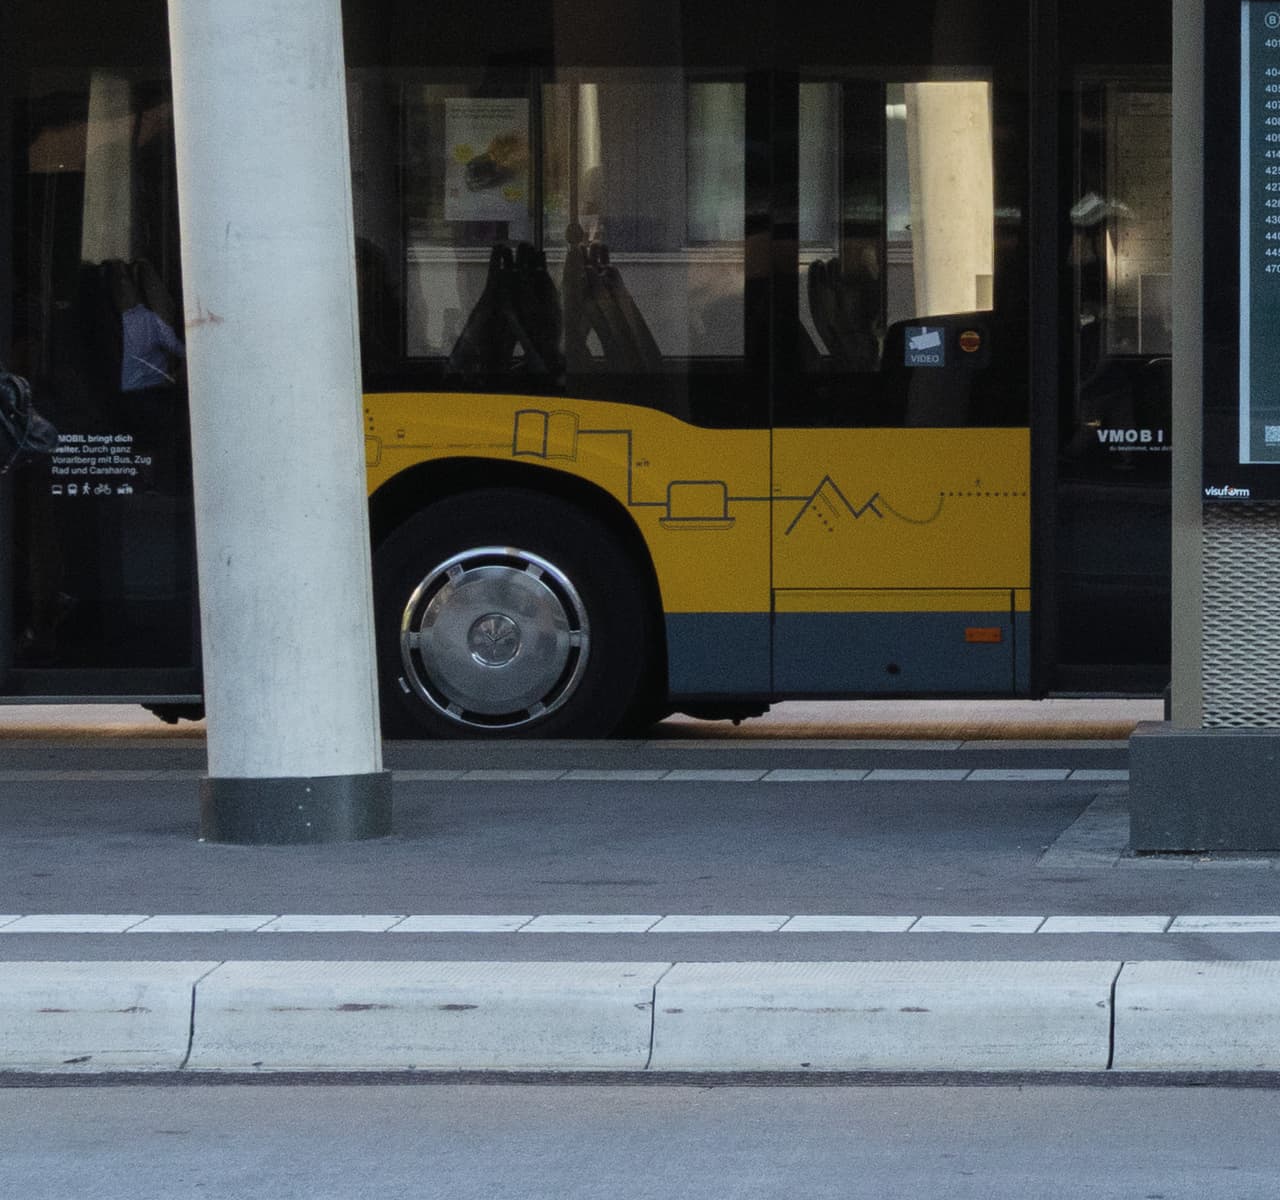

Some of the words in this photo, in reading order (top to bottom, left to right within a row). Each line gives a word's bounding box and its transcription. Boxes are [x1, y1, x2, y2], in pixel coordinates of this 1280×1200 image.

[1265, 39, 1280, 48] 401
[1266, 150, 1280, 159] 414
[911, 355, 939, 363] VIDEO
[82, 445, 108, 453] Durch
[110, 447, 131, 455] ganz
[98, 455, 112, 463] mit
[52, 466, 70, 474] Rad
[71, 466, 88, 474] und
[1205, 484, 1250, 496] visuform
